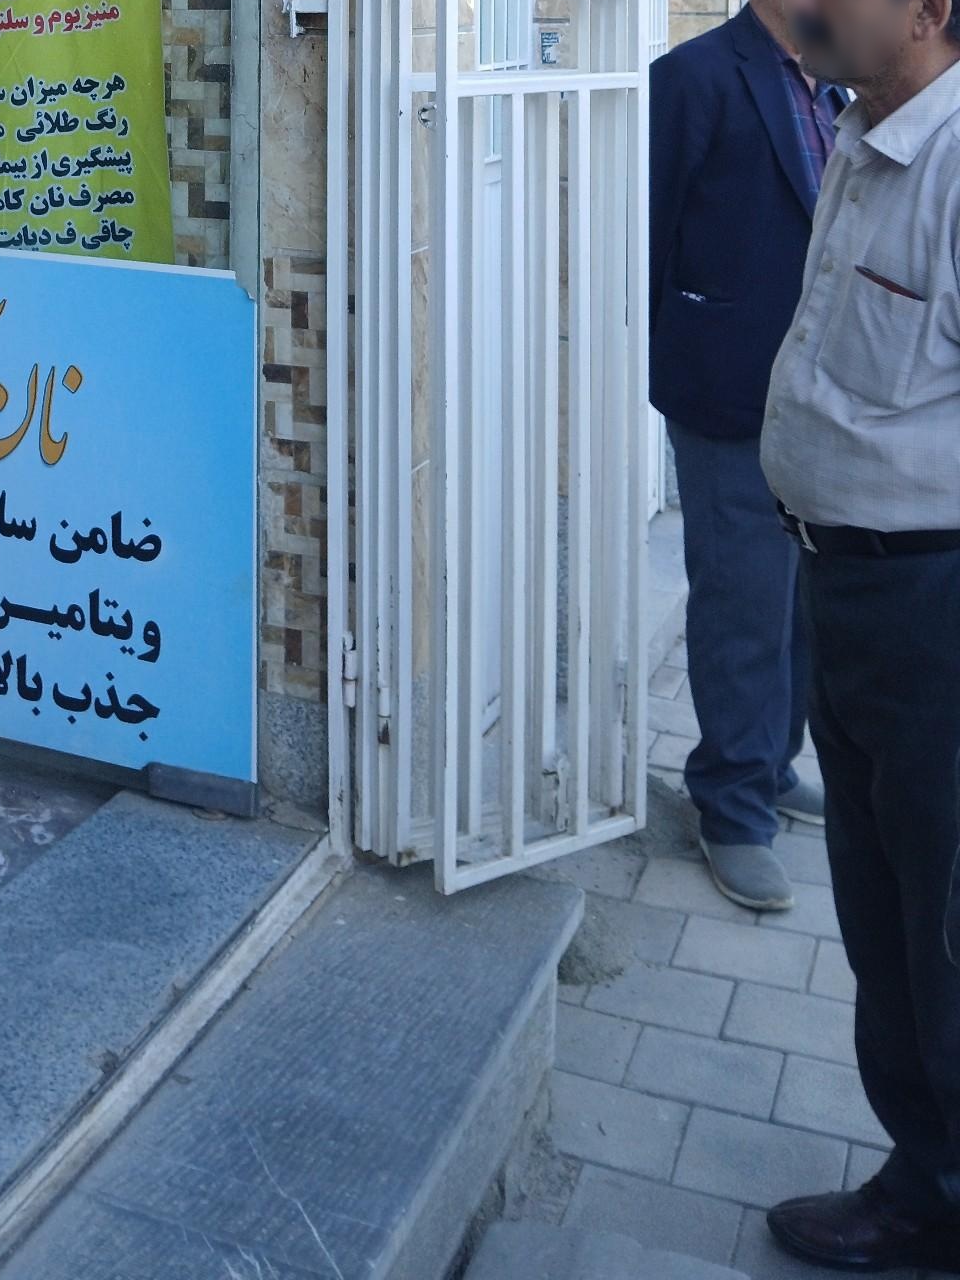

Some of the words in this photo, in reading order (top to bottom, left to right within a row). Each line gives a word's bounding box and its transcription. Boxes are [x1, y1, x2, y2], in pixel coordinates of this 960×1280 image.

[33, 14, 46, 34] و
[47, 1, 121, 32] منیزیوم
[9, 75, 69, 107] میزان
[15, 110, 81, 143] طلائی
[85, 107, 130, 137] رنگ
[29, 149, 49, 179] از
[50, 146, 133, 178] پیشگیری
[29, 184, 66, 218] نان
[66, 183, 135, 213] مصرف
[54, 221, 77, 246] ف
[80, 220, 134, 251] چاقی
[49, 510, 163, 563] ضامن
[52, 671, 162, 742] جذب
